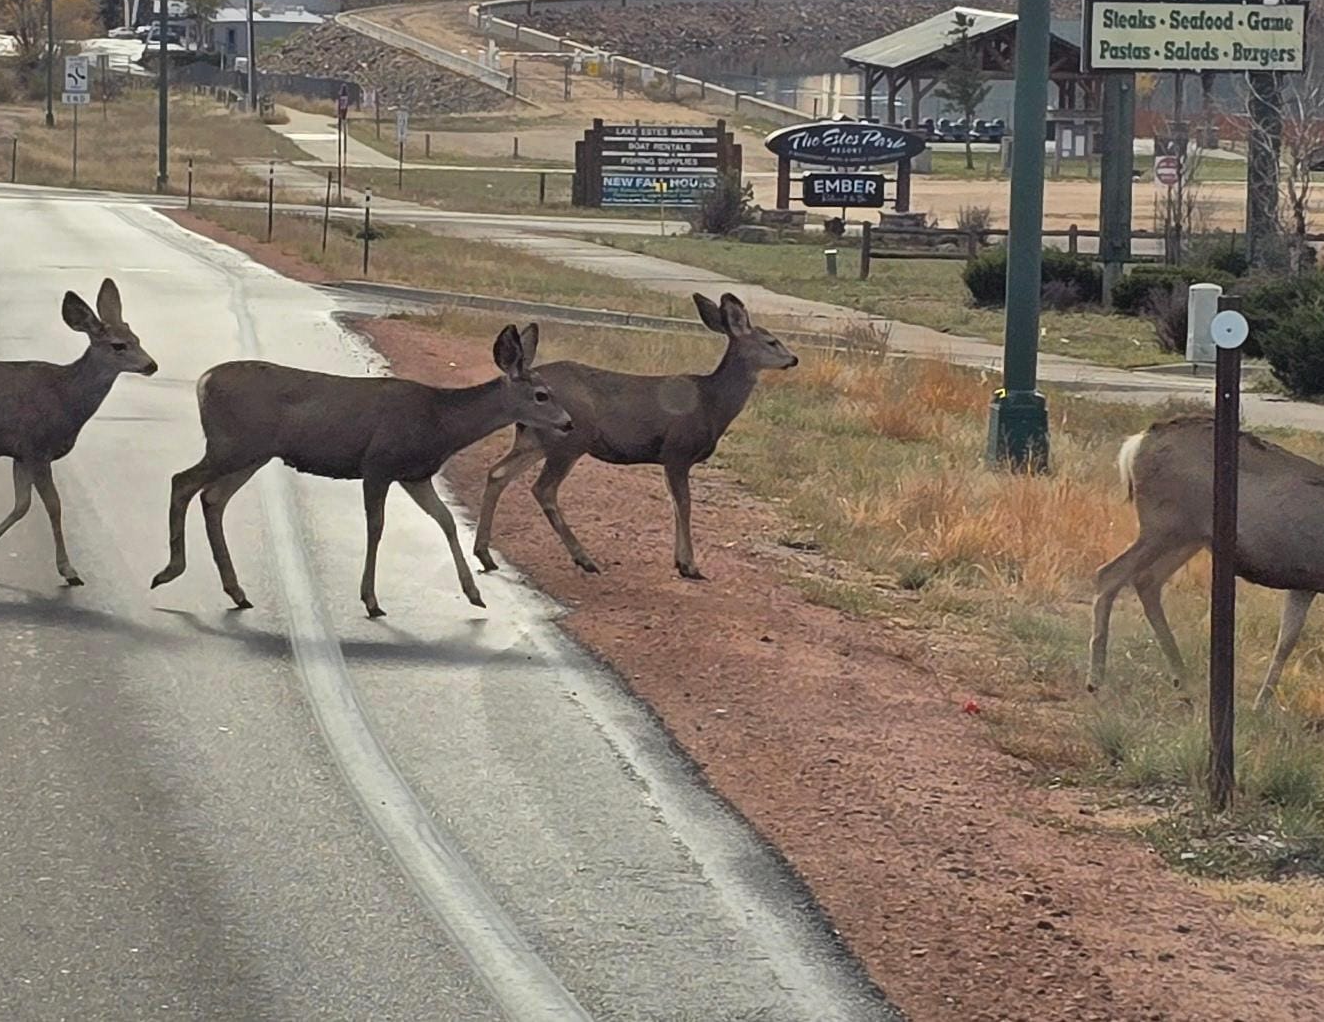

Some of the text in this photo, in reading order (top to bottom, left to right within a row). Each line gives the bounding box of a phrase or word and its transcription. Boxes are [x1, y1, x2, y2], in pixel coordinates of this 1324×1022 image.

[1103, 9, 1294, 31] Steaks Seafood Game
[1100, 40, 1296, 66] Pastas Salads Burgers
[616, 128, 704, 137] LAKE ESTES MARINA
[788, 128, 906, 150] The Estes Park
[653, 143, 692, 152] RENTALS
[658, 158, 698, 166] SUPPLIES
[603, 177, 634, 187] NEW
[636, 178, 667, 188] FAL
[813, 179, 877, 194] EMBER
